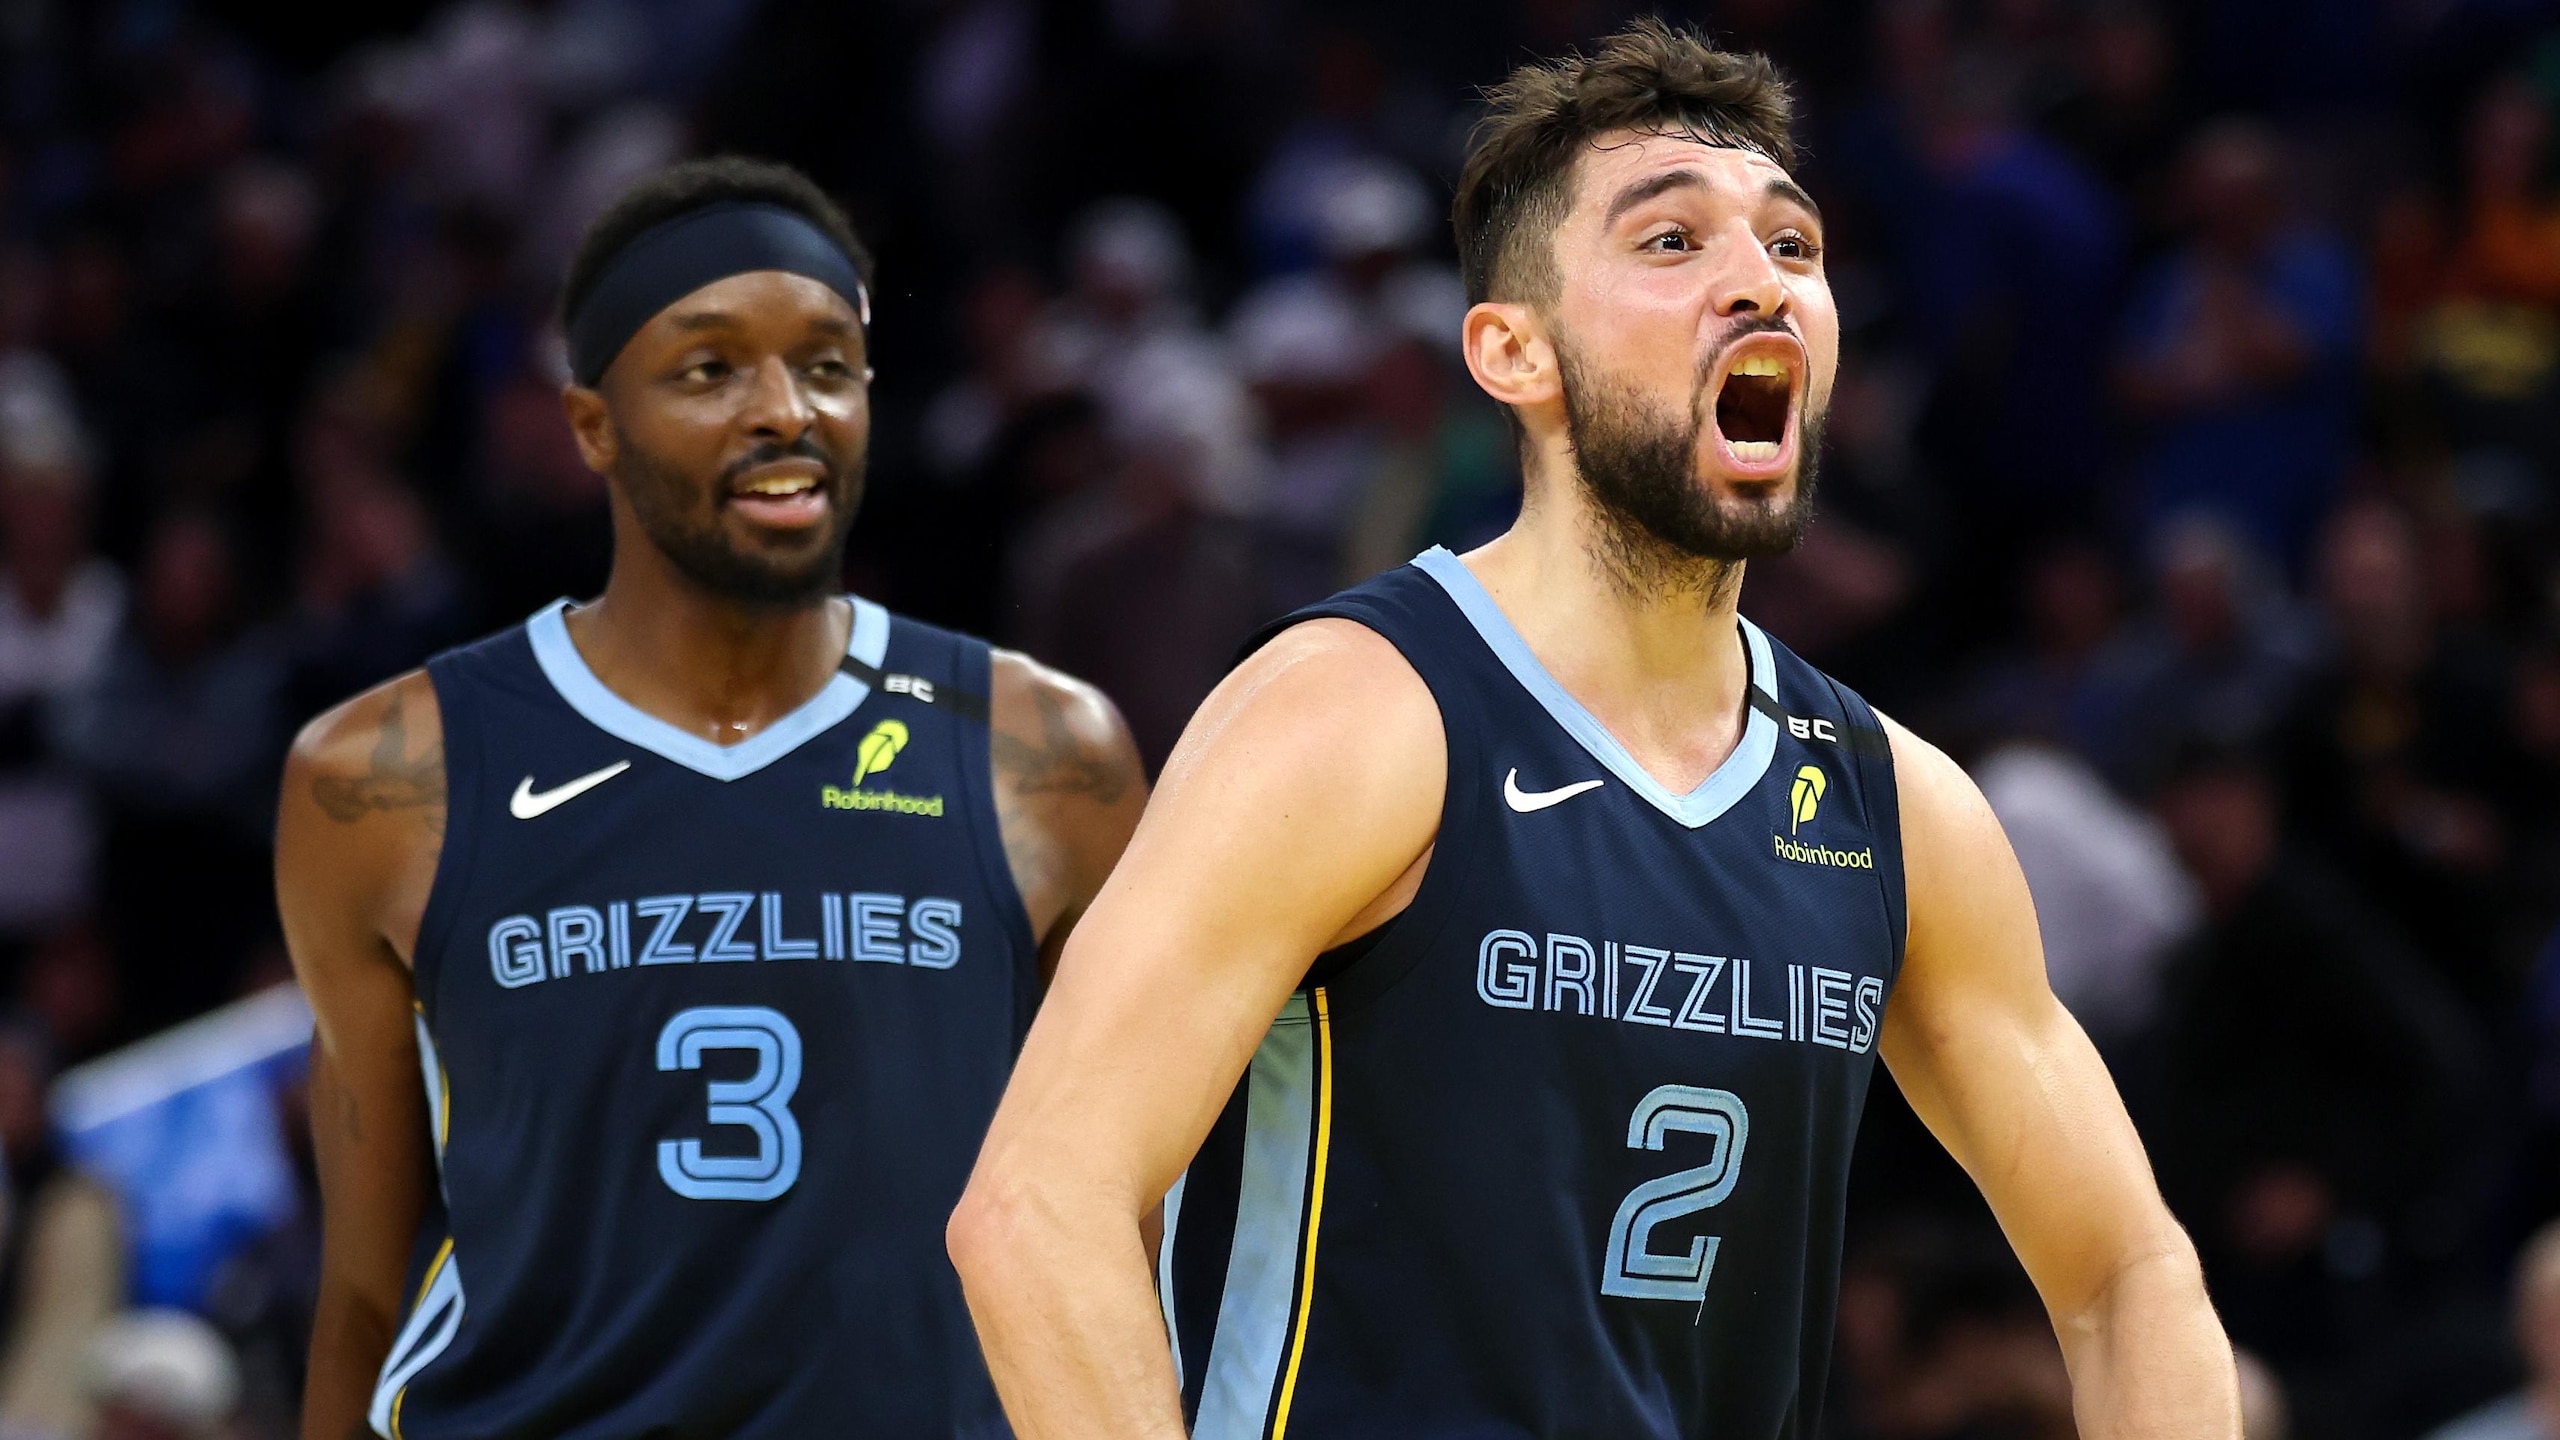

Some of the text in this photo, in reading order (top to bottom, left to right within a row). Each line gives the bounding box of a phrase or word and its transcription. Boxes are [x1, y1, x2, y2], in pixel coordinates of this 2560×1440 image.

[884, 673, 934, 703] BC
[1787, 715, 1837, 743] BC
[821, 784, 944, 817] Robinhood
[1774, 834, 1873, 869] Robinhood
[487, 891, 963, 990] GRIZZLIES
[1476, 928, 1884, 1055] GRIZZLIES
[656, 1005, 801, 1201] 3
[1601, 1084, 1749, 1301] 2
